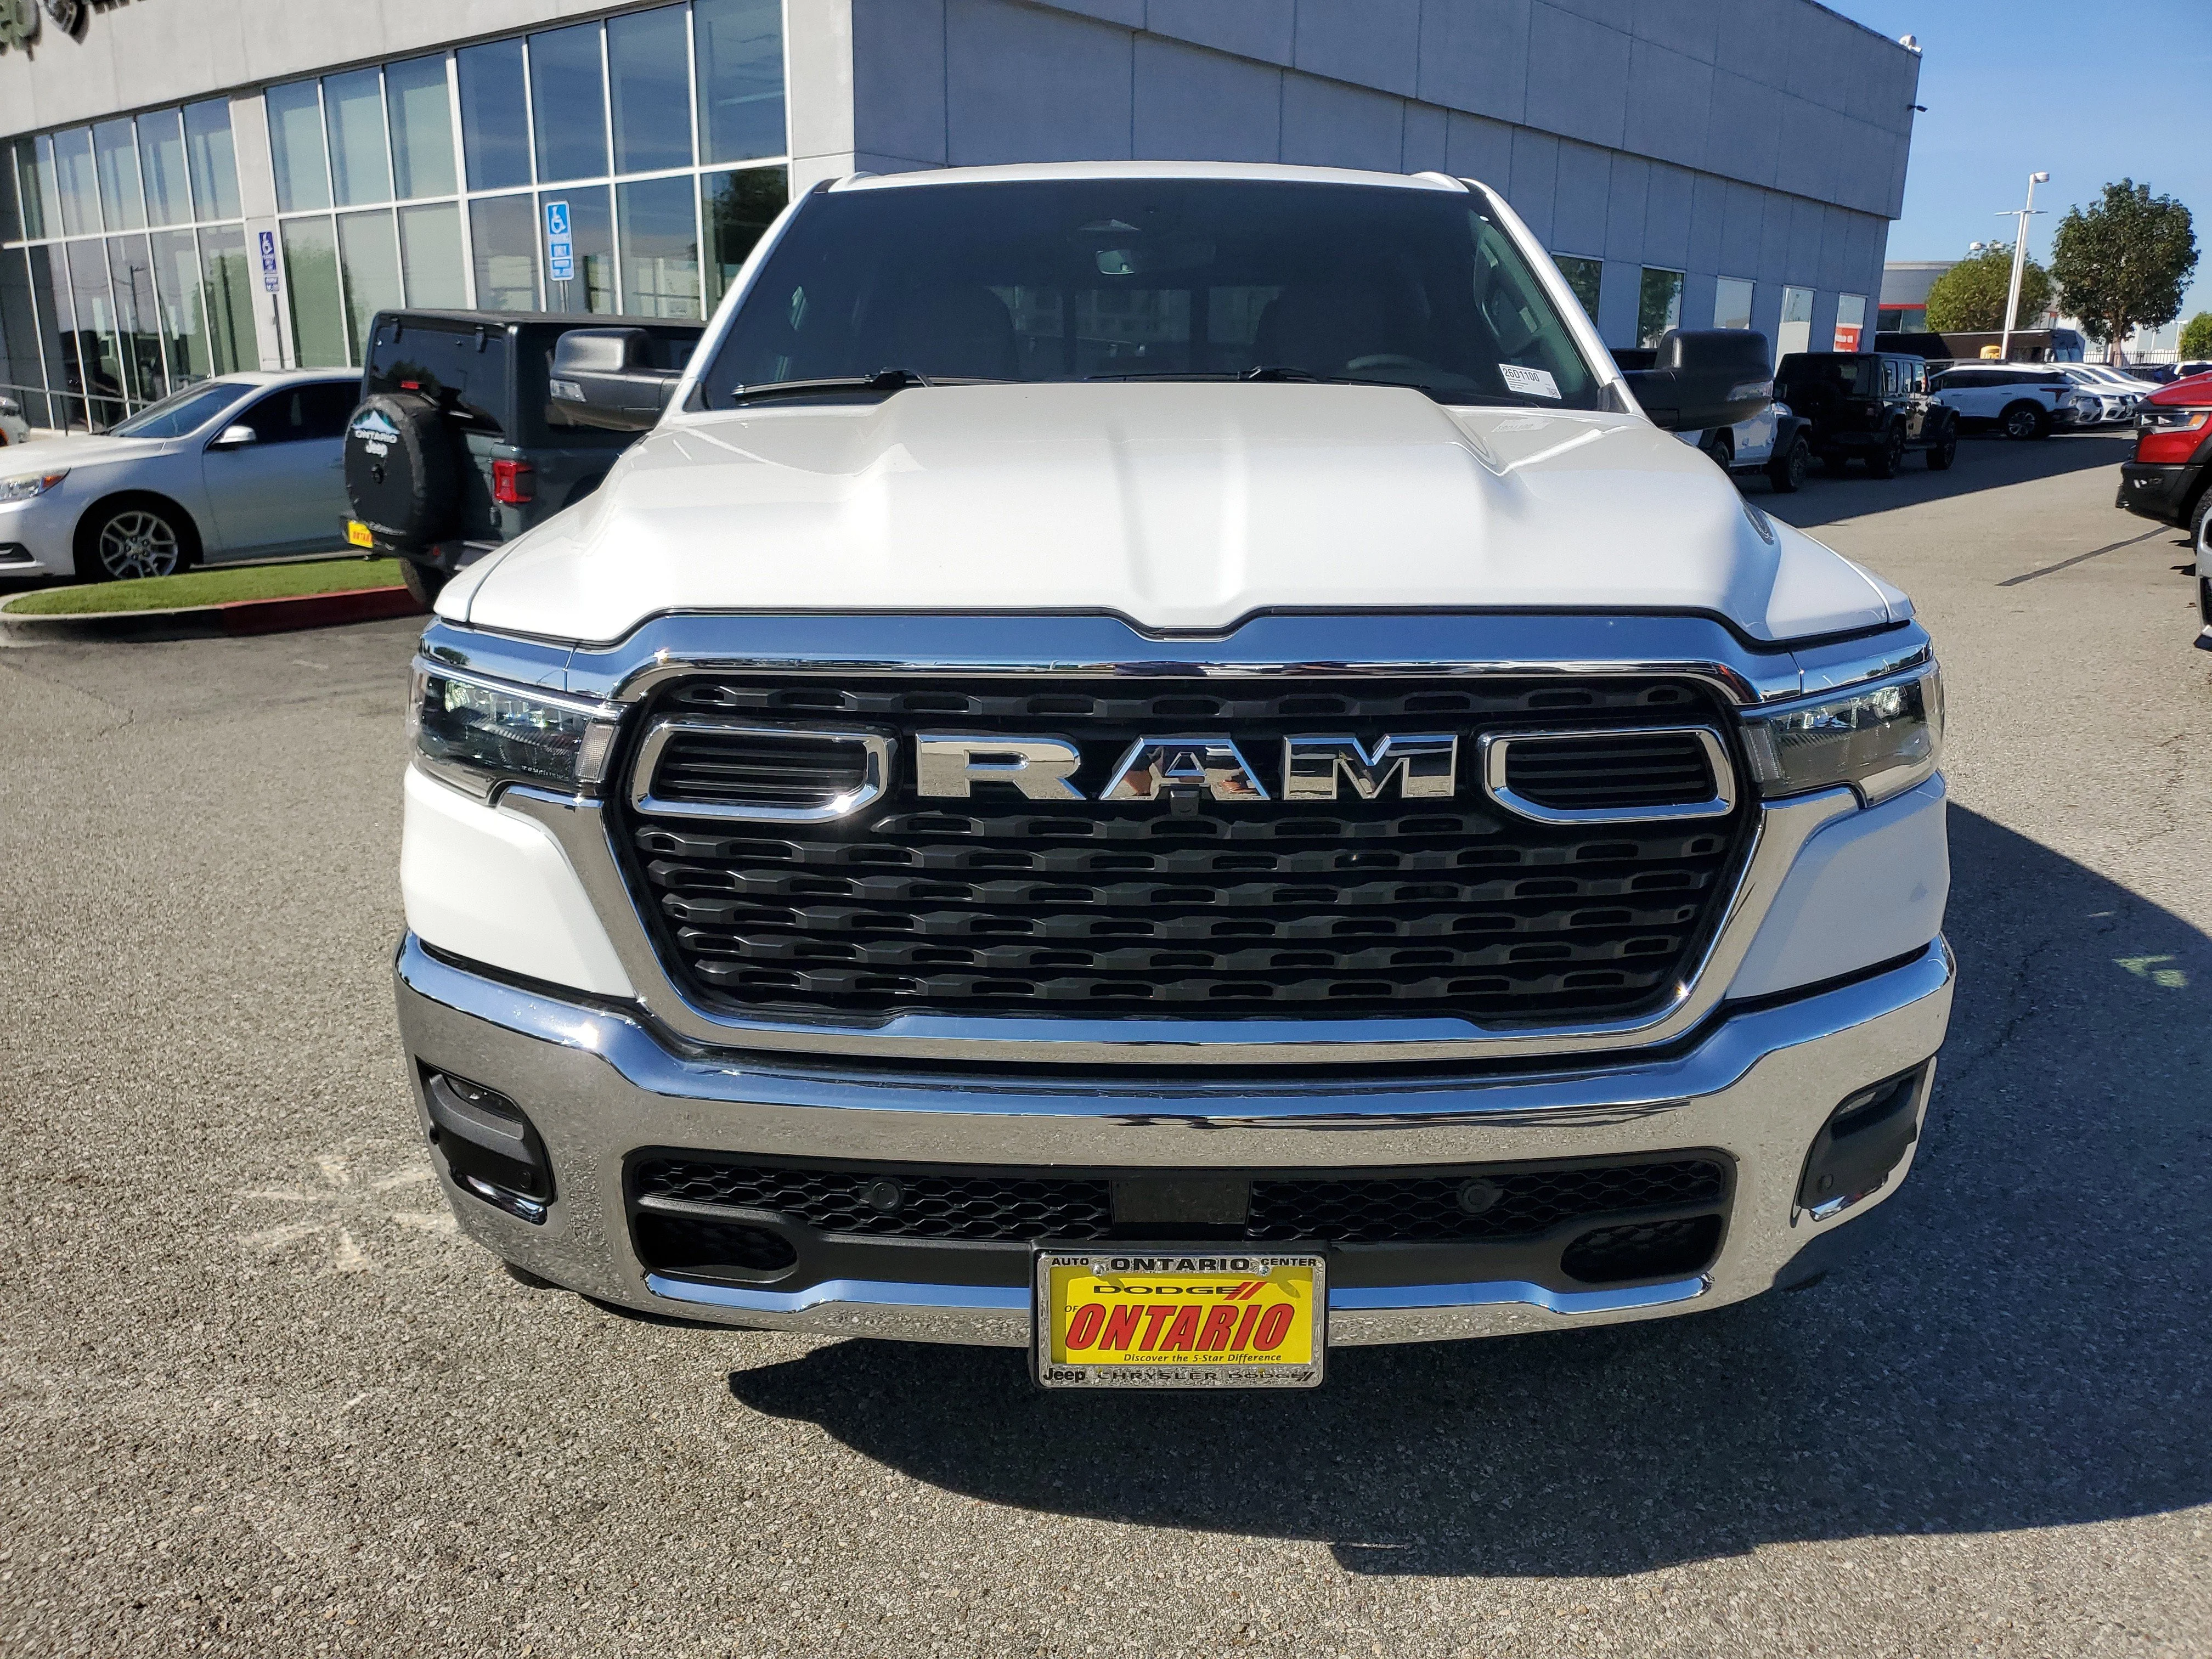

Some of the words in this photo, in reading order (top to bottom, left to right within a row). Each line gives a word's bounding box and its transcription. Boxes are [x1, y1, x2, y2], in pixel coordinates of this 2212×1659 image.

[1503, 368, 1540, 382] 26D1100
[916, 731, 1458, 801] RAM
[1052, 1257, 1089, 1266] AUTO
[1110, 1258, 1250, 1271] ONTARIO
[1261, 1258, 1317, 1266] CENTER
[1093, 1285, 1241, 1295] DODGE
[1065, 1303, 1295, 1351] ONTARIO
[1124, 1353, 1169, 1362] Discover
[1172, 1353, 1188, 1362] the
[1192, 1354, 1224, 1362] 5-Star
[1227, 1353, 1282, 1363] Difference
[1043, 1367, 1086, 1383] Jeep
[1098, 1372, 1218, 1380] CHRYSLER
